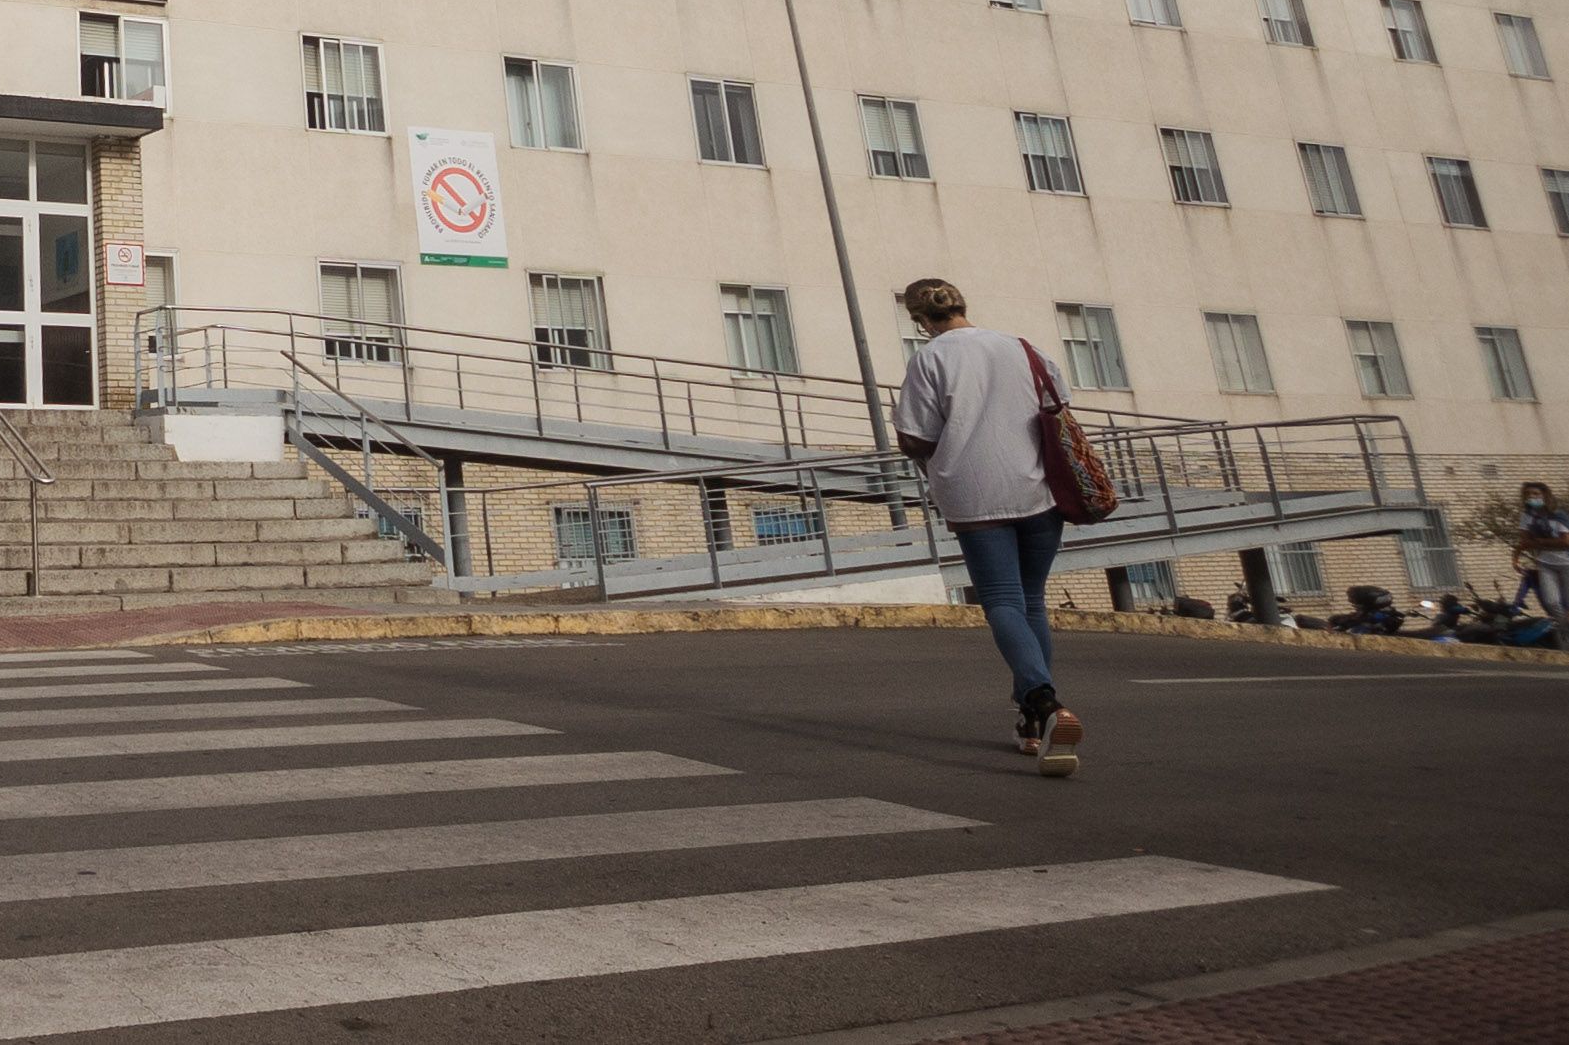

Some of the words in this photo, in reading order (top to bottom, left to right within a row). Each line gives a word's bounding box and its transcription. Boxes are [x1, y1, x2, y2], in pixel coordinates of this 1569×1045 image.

[422, 162, 439, 186] FUMAR
[438, 157, 448, 167] EN
[448, 156, 467, 167] TODO
